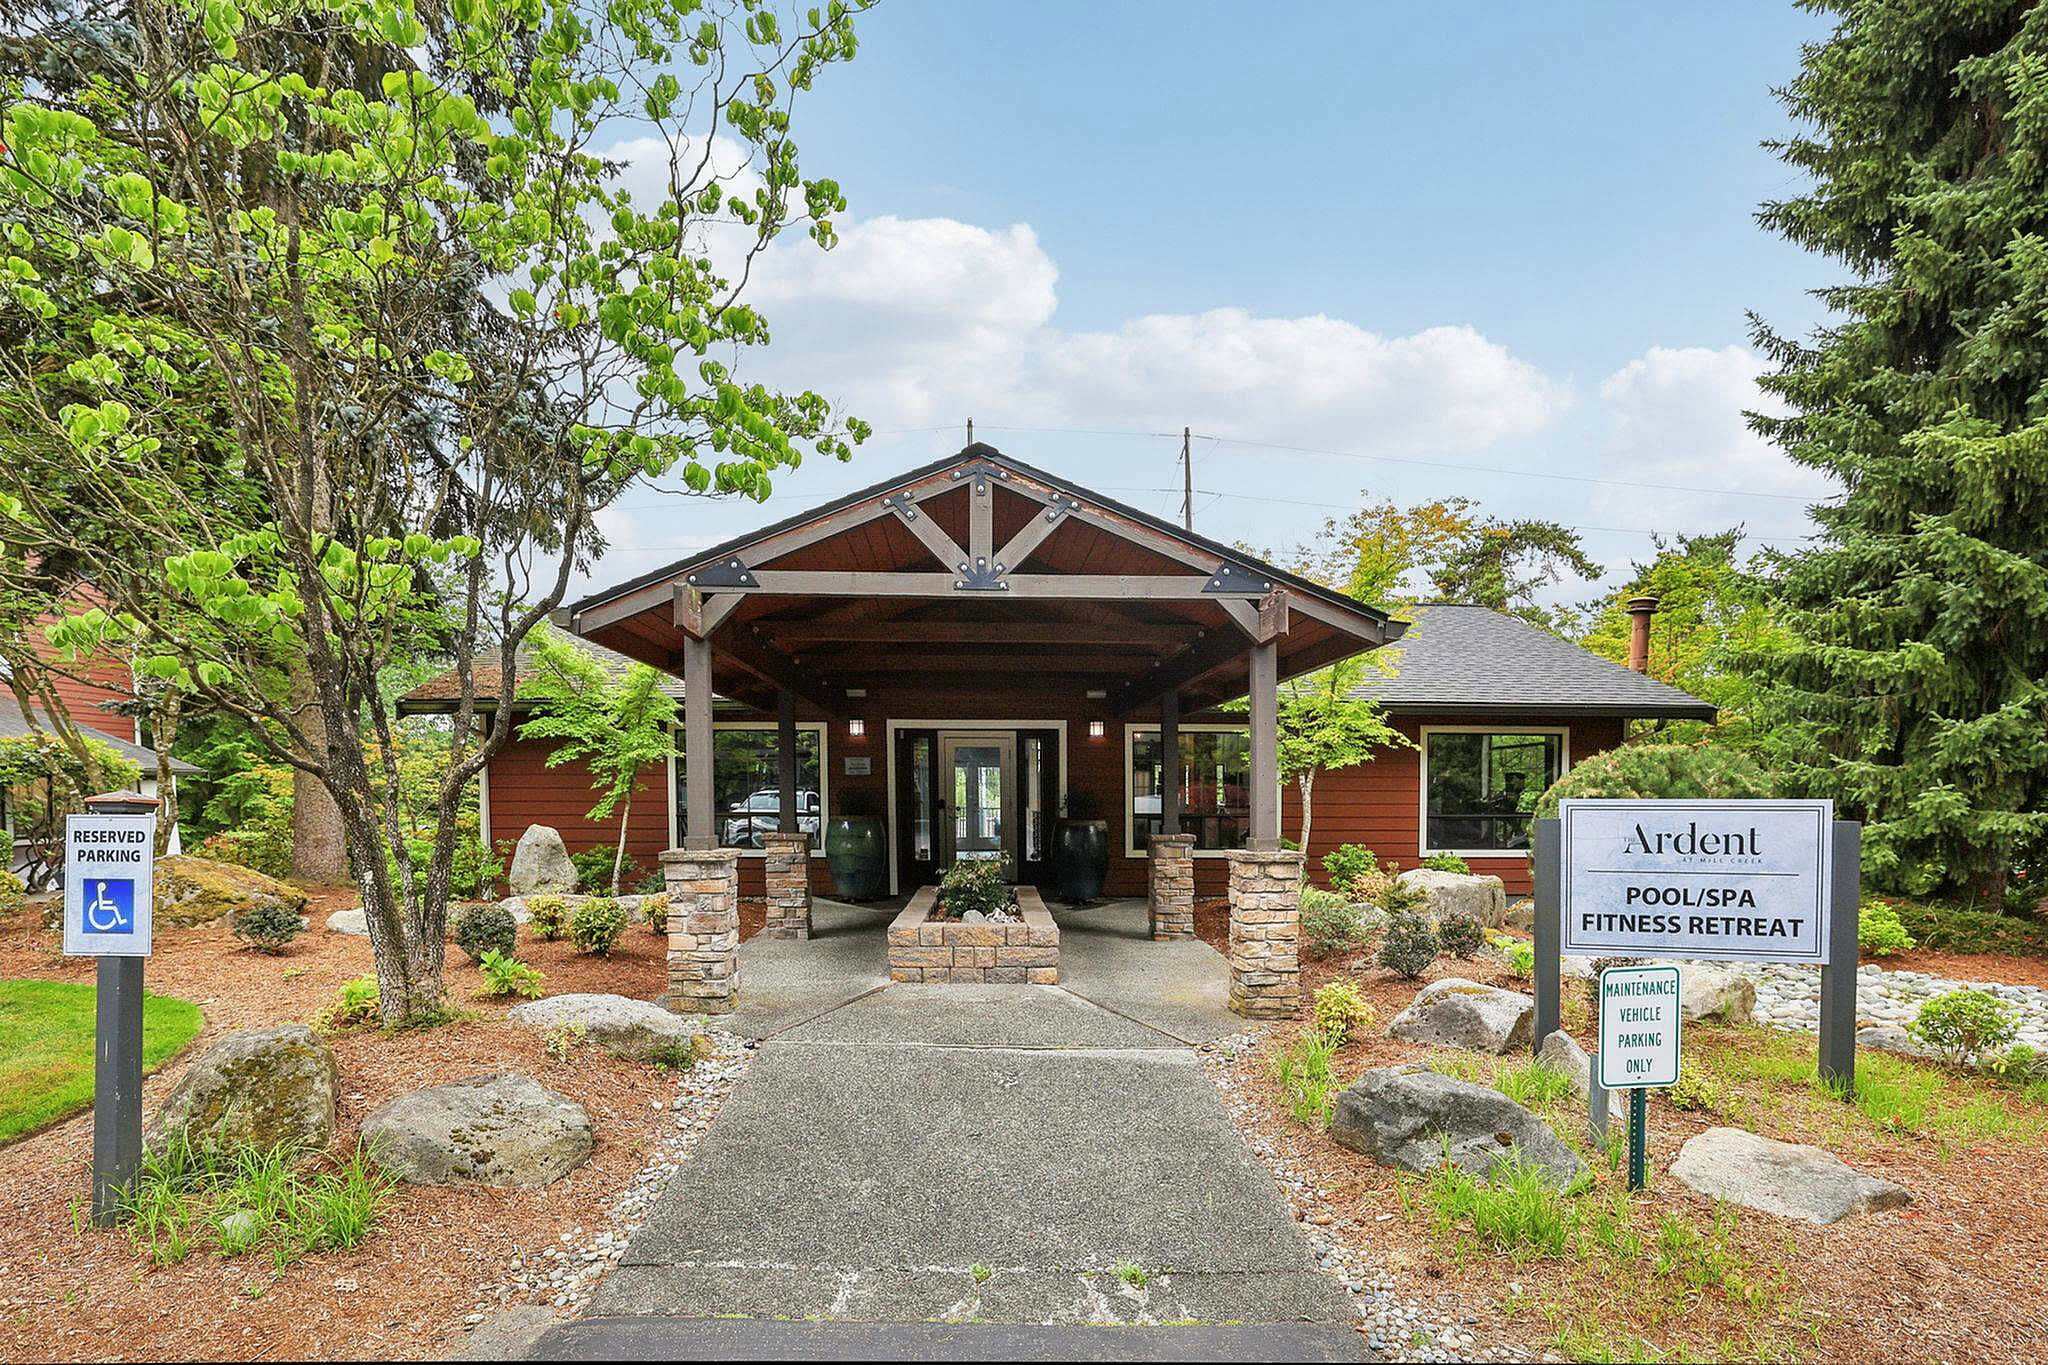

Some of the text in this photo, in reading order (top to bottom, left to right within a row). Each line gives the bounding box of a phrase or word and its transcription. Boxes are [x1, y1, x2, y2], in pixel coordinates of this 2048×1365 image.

[74, 830, 146, 843] RESERVED
[1623, 822, 1762, 855] Ardent
[77, 849, 141, 862] PARKING
[1626, 886, 1756, 908] POOL/SPA
[1582, 913, 1804, 937] FITNESS RETREAT
[1606, 980, 1676, 997] MAINTENANCE
[1620, 1007, 1661, 1022] VEHICLE
[1618, 1032, 1662, 1048] PARKING
[1626, 1058, 1653, 1073] ONLY
